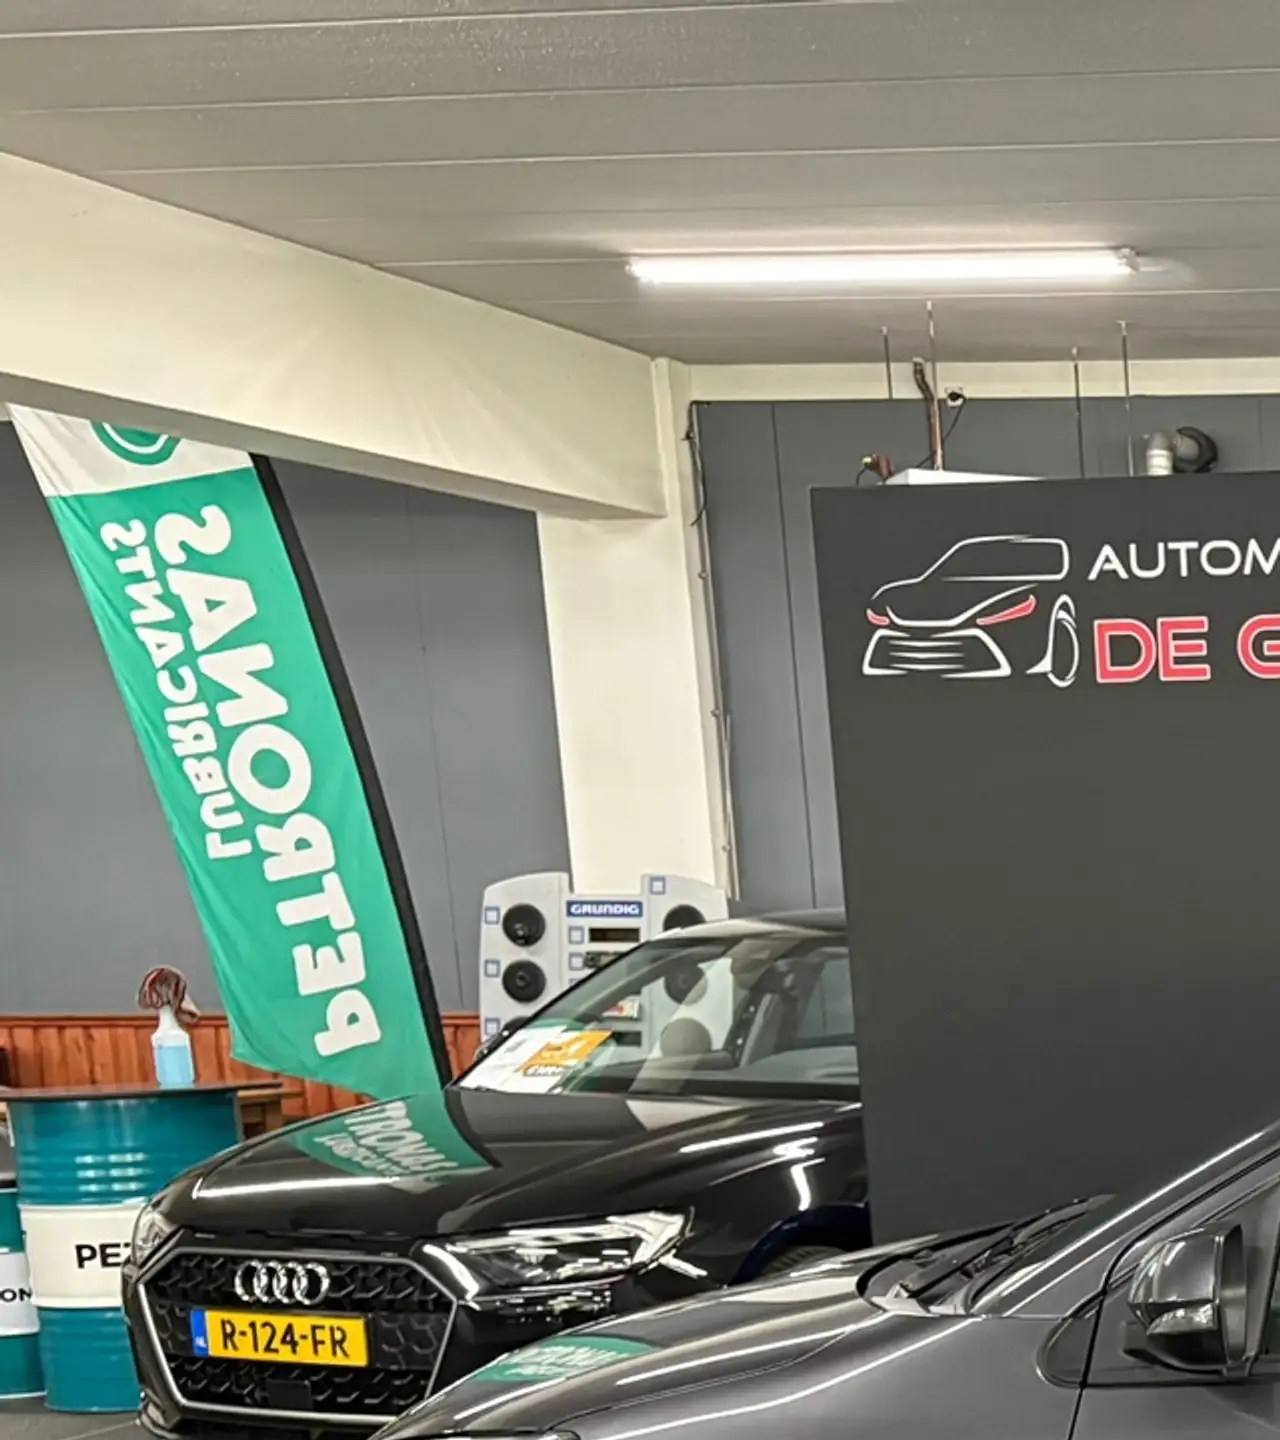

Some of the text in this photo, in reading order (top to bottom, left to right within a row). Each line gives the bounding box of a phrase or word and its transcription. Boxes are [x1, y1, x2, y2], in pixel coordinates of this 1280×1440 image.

[1094, 616, 1211, 684] DE
[570, 903, 640, 915] GRUNDIG
[75, 1242, 131, 1269] PE
[0, 1287, 33, 1302] ON
[220, 1318, 350, 1358] R-124-FR
